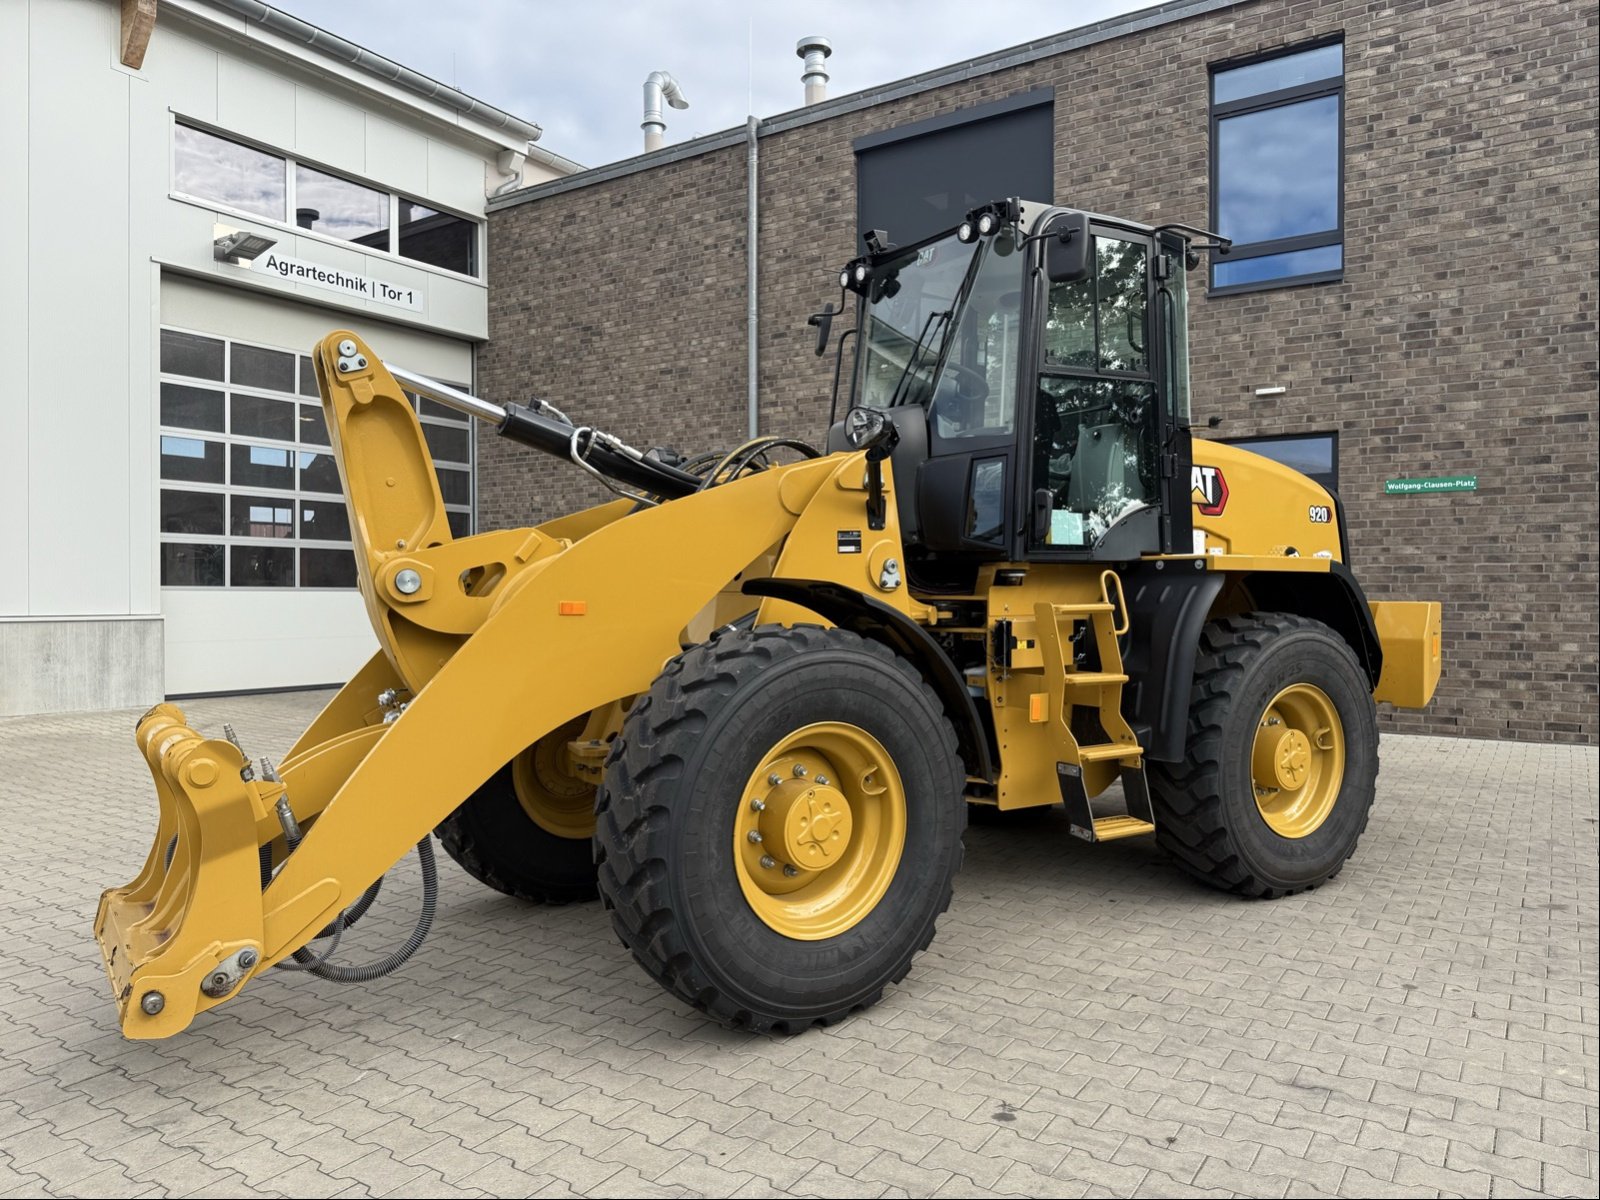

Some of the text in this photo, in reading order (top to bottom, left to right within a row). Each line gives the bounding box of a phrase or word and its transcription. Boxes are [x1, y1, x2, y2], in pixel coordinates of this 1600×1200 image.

[266, 254, 367, 293] Agrartechnik
[380, 284, 403, 301] Tor
[407, 291, 413, 304] 1
[1191, 466, 1216, 504] AT
[1387, 480, 1475, 490] Wolfgang-Clausen-Platz
[1309, 506, 1328, 522] 920
